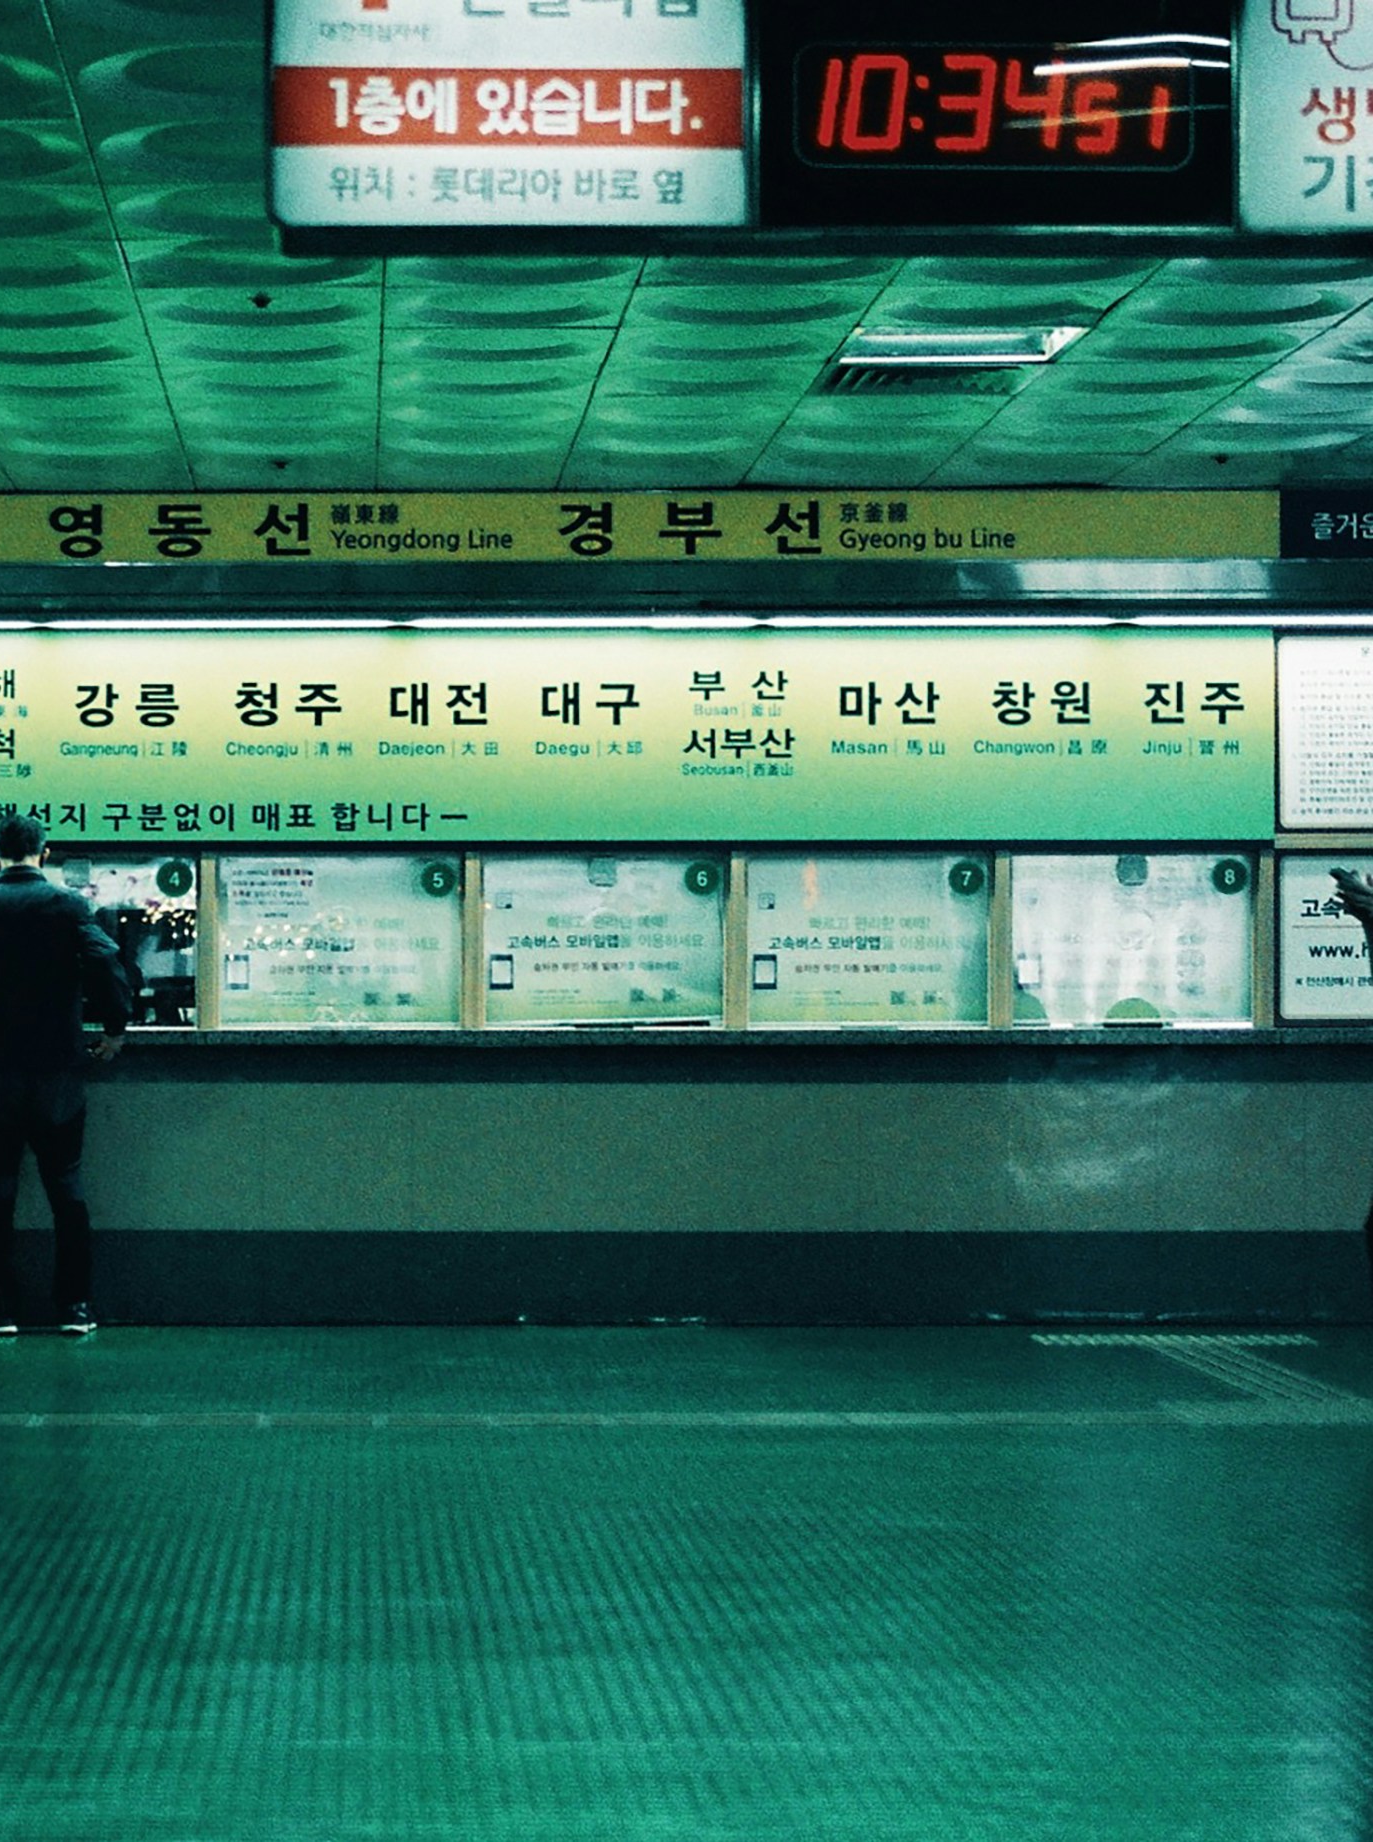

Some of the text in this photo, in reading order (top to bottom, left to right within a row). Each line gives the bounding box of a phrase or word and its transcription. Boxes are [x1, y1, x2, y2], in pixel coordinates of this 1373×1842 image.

[329, 75, 702, 136] 1층에 있습니다.
[1301, 85, 1373, 145] 생
[329, 167, 394, 202] 위치
[432, 168, 561, 203] 롯데리아
[574, 168, 640, 203] 바로
[654, 168, 683, 204] 옆
[1302, 154, 1373, 213] 기
[49, 503, 311, 558] 영동선
[331, 528, 513, 552] Yeongdong Line
[558, 501, 822, 557] 경부선
[839, 527, 1017, 552] Gyeong bu Line
[689, 670, 788, 700] 부산
[75, 683, 180, 727] 강릉
[235, 682, 342, 727] 청주
[389, 682, 488, 726] 대전
[541, 682, 640, 726] 대구
[694, 703, 738, 716] Busan
[839, 681, 940, 726] 마산
[992, 681, 1091, 726] 창원
[1144, 681, 1245, 725] 진주
[60, 742, 138, 758] Gangneung
[226, 742, 298, 758] Cheongju
[378, 741, 445, 757] Daejeon
[535, 741, 590, 757] Daegu
[682, 728, 795, 759] 서부산
[831, 740, 888, 755] Masan
[973, 740, 1055, 756] Changwon
[1143, 740, 1182, 756] Jinju
[681, 763, 745, 777] Seobusan
[102, 803, 235, 832] 구분없이
[252, 803, 315, 831] 매표
[332, 802, 430, 832] 합니다
[169, 872, 182, 887] 4
[433, 872, 445, 888] 5
[697, 871, 708, 887] 6
[961, 871, 971, 887] 7
[1223, 870, 1235, 886] 8
[1300, 897, 1347, 919] 고속
[508, 935, 560, 949] 고속버스
[769, 936, 823, 950] 고속버스
